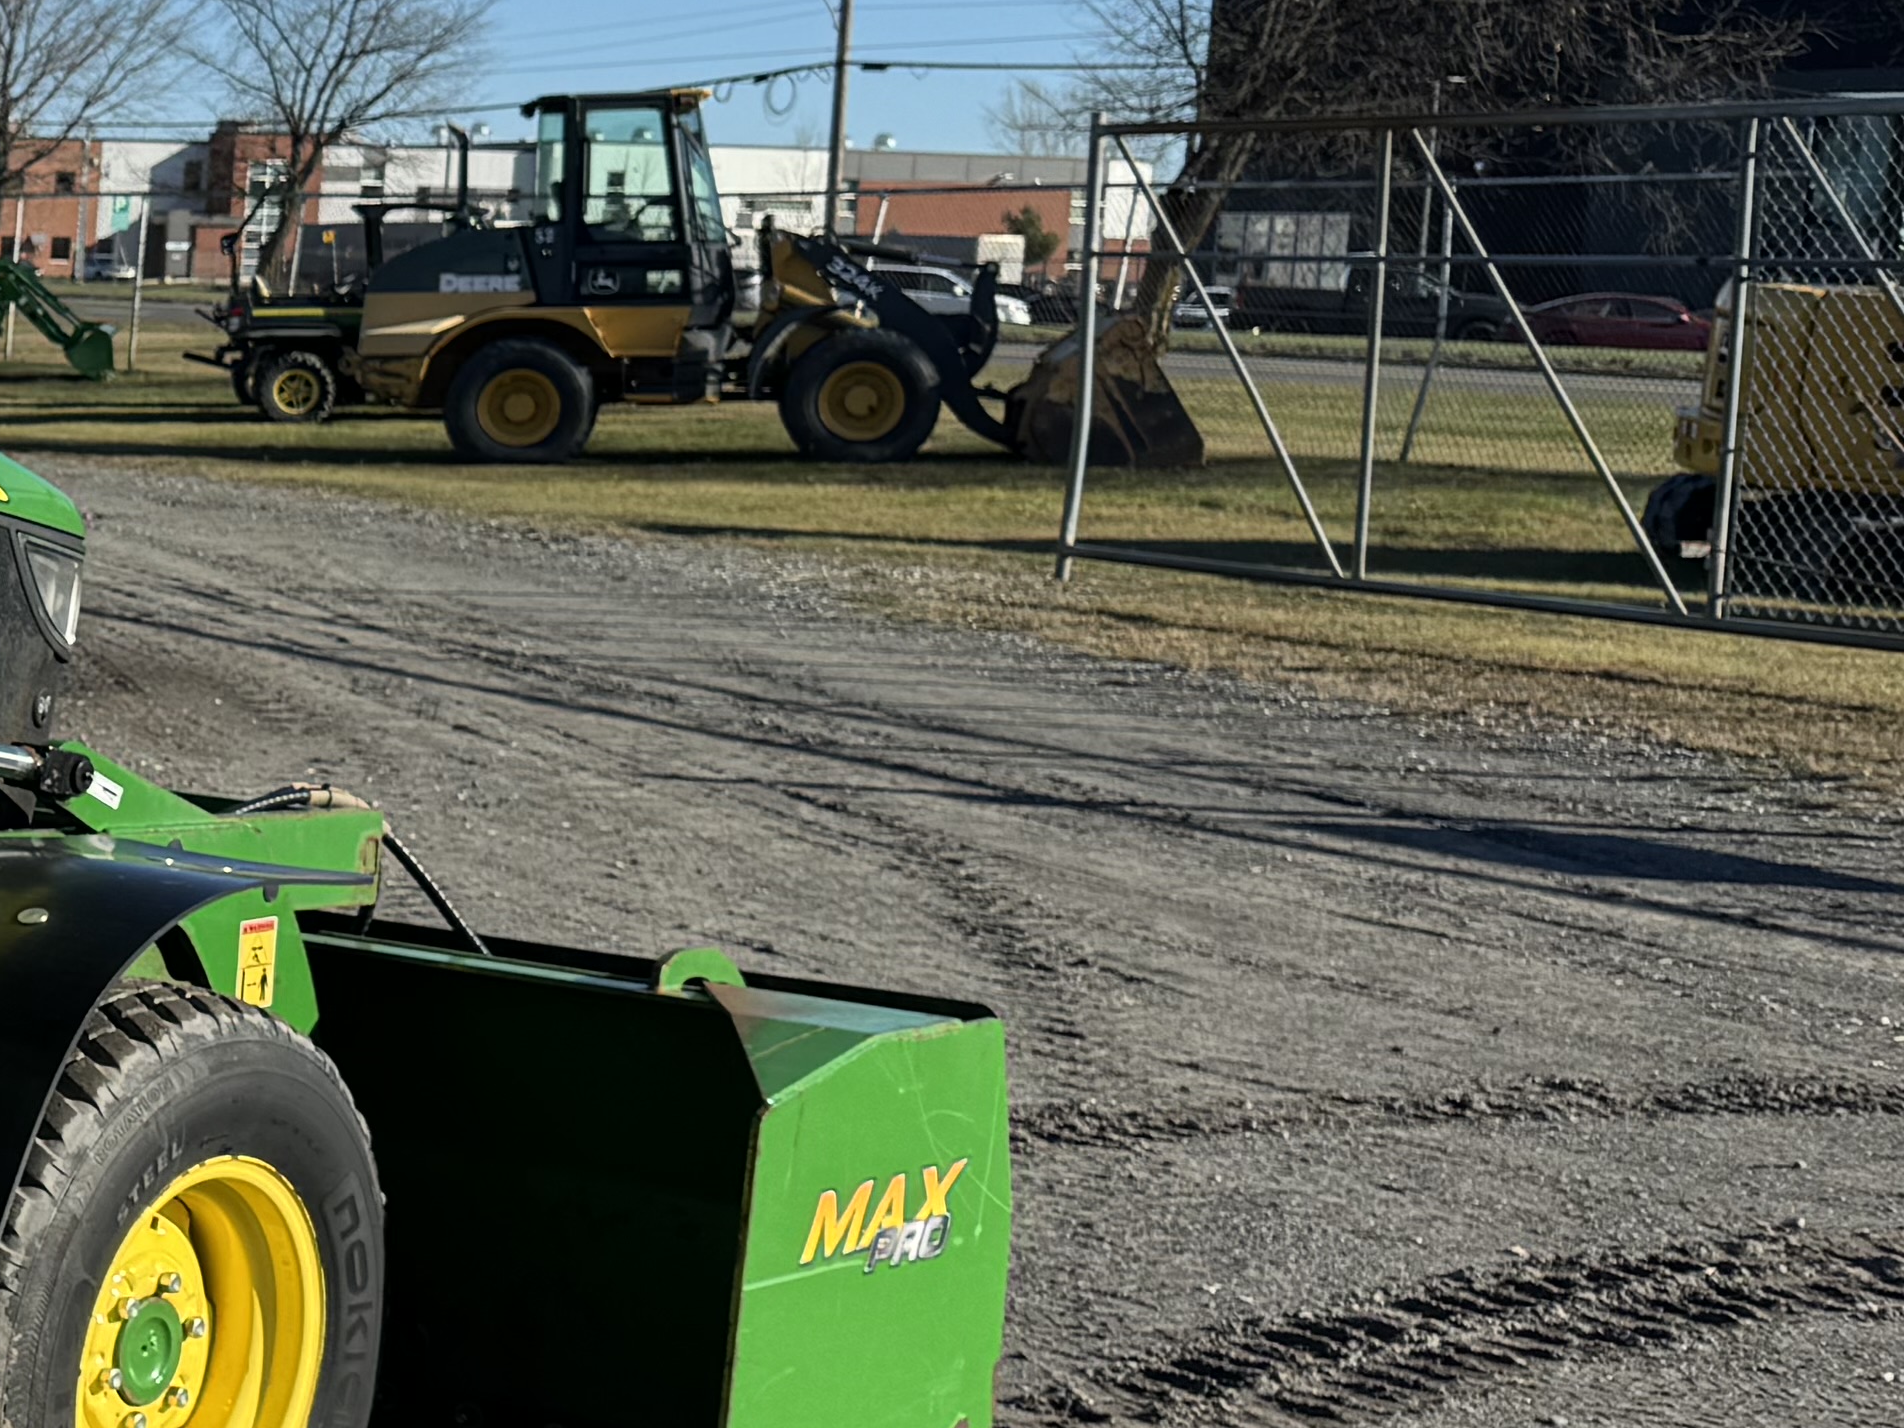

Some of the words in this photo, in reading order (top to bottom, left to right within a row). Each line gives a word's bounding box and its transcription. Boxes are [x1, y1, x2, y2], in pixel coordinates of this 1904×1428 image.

[440, 274, 520, 292] DEERE
[117, 1137, 182, 1228] STEEL
[799, 1157, 968, 1265] MAX
